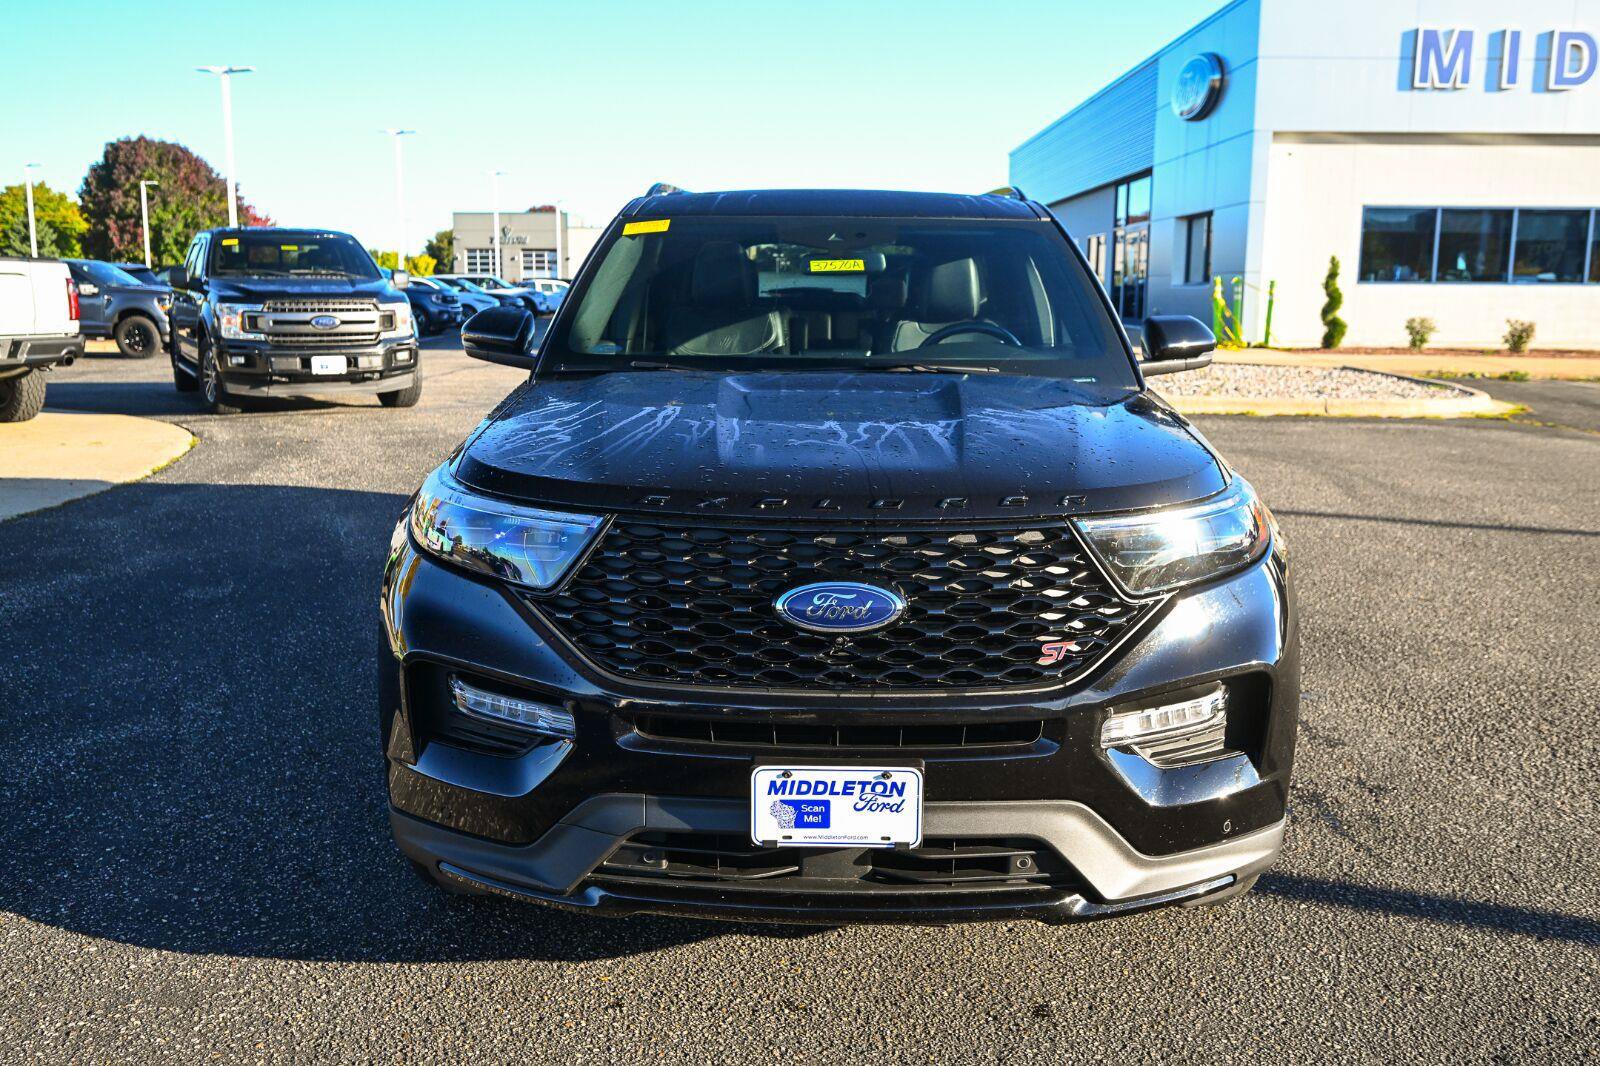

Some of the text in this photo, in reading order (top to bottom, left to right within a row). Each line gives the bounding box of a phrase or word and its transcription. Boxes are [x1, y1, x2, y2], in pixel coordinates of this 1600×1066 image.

[806, 592, 873, 620] Ford
[1039, 640, 1077, 662] ST
[767, 780, 906, 797] MIDDLETON
[801, 804, 825, 813] Scan
[853, 792, 906, 814] Ford
[804, 815, 822, 823] Me!
